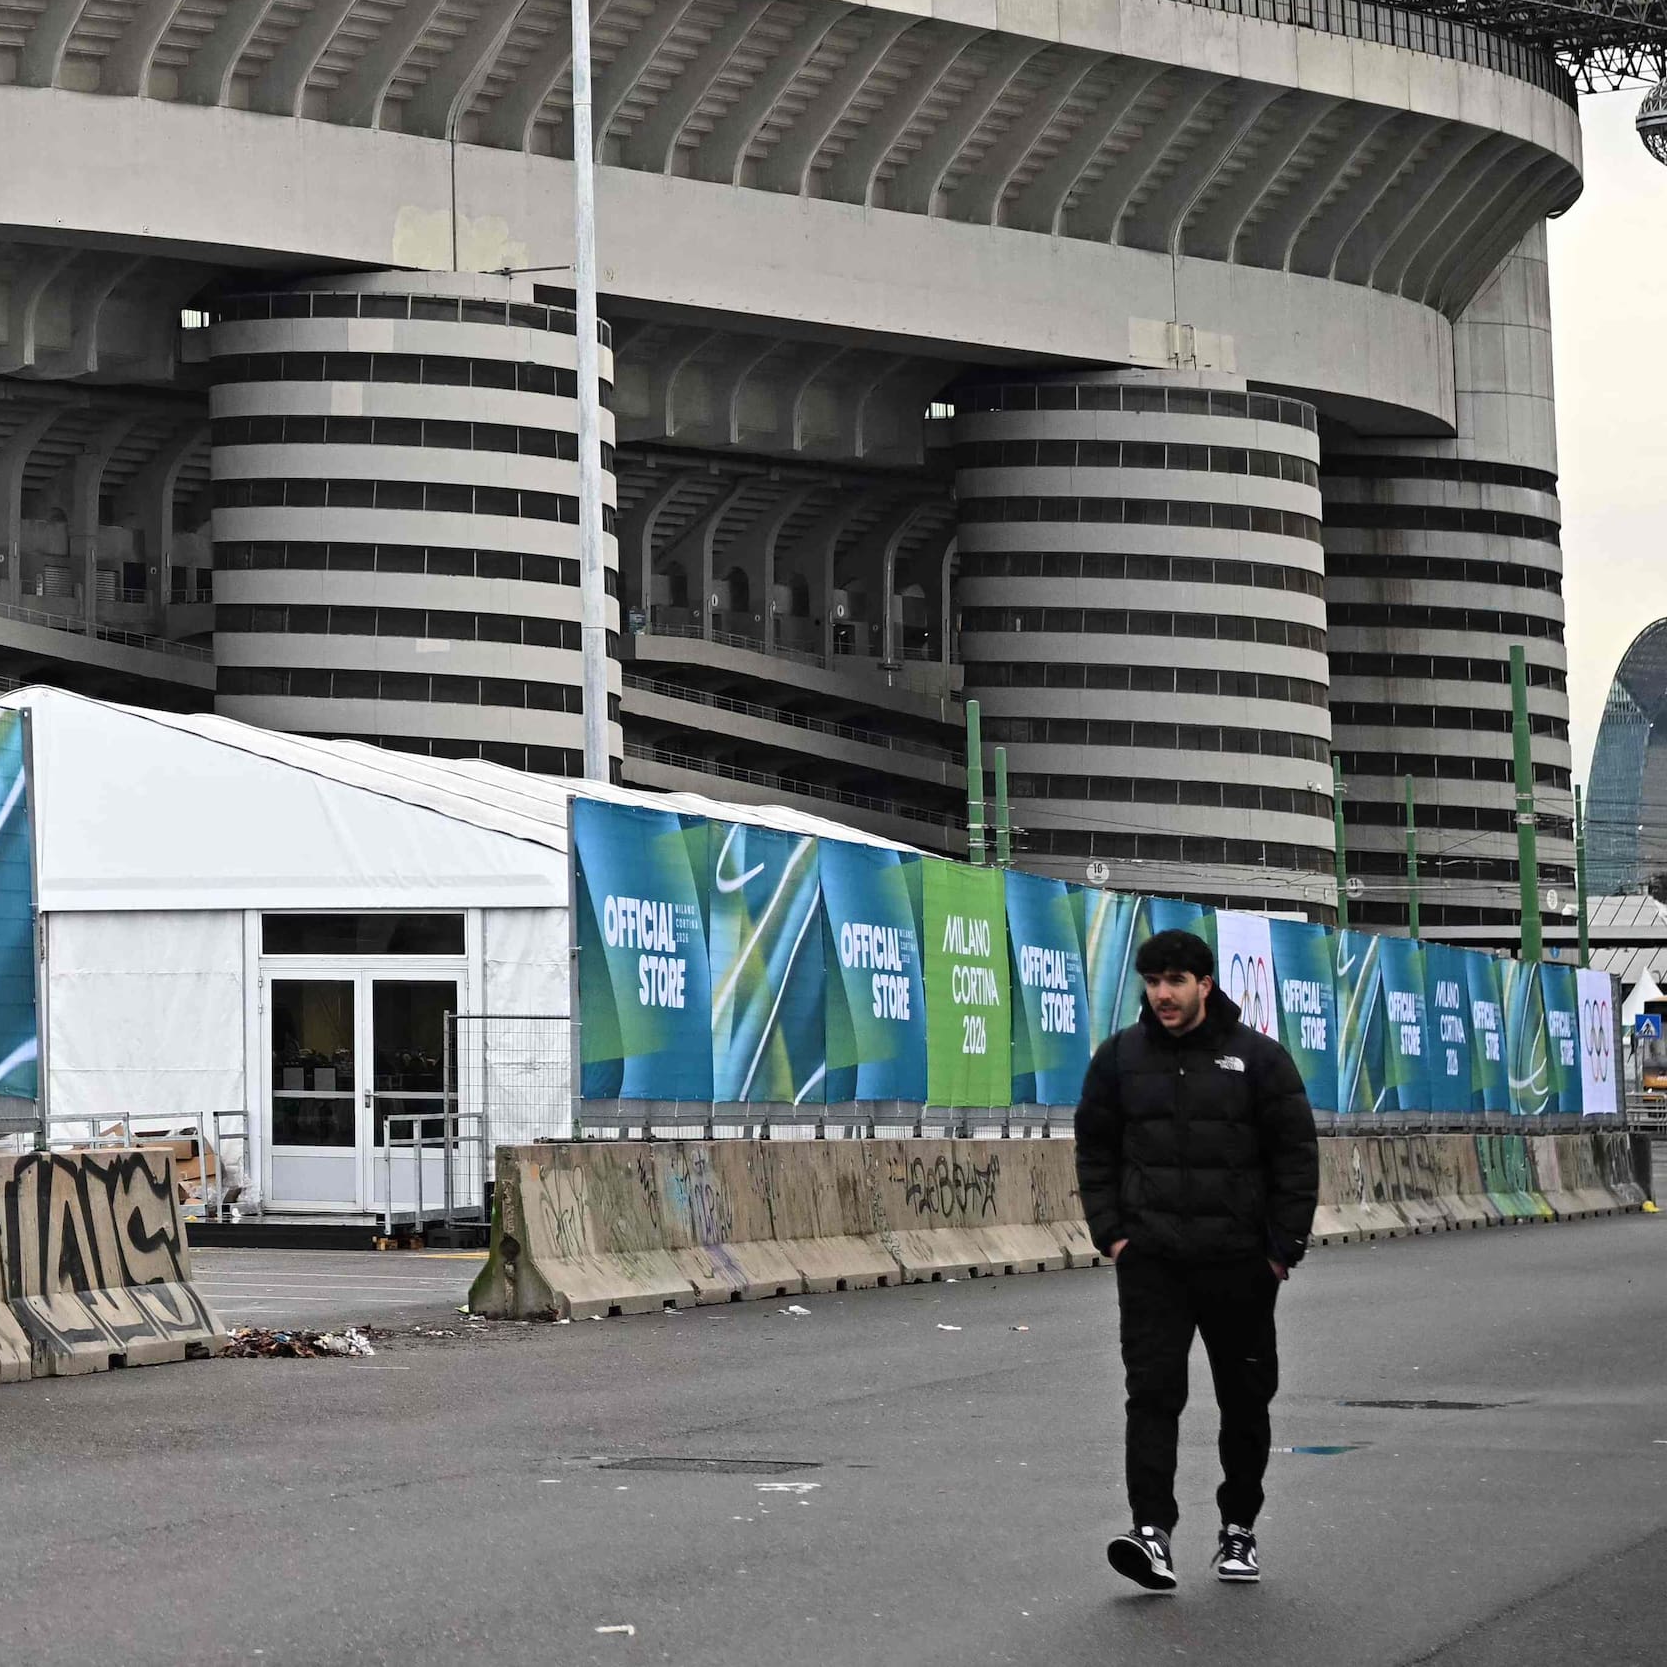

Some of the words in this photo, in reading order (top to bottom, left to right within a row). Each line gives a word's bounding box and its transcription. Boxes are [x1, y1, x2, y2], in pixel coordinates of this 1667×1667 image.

[604, 895, 676, 953] OFFICIAL
[942, 914, 991, 957] MILANO
[841, 922, 902, 971] OFFICIAL
[1021, 944, 1068, 990] OFFICIAL
[639, 955, 685, 1009] STORE
[872, 973, 910, 1020] STORE
[952, 964, 1000, 1007] CORTINA
[1283, 979, 1322, 1015] OFFICIAL
[1435, 981, 1460, 1009] MILANO
[1041, 992, 1076, 1034] STORE
[1388, 991, 1417, 1023] OFFICIAL
[962, 1015, 987, 1054] 2026
[1301, 1016, 1327, 1051] STORE
[1400, 1025, 1421, 1056] STORE
[1440, 1014, 1467, 1044] CORTINA
